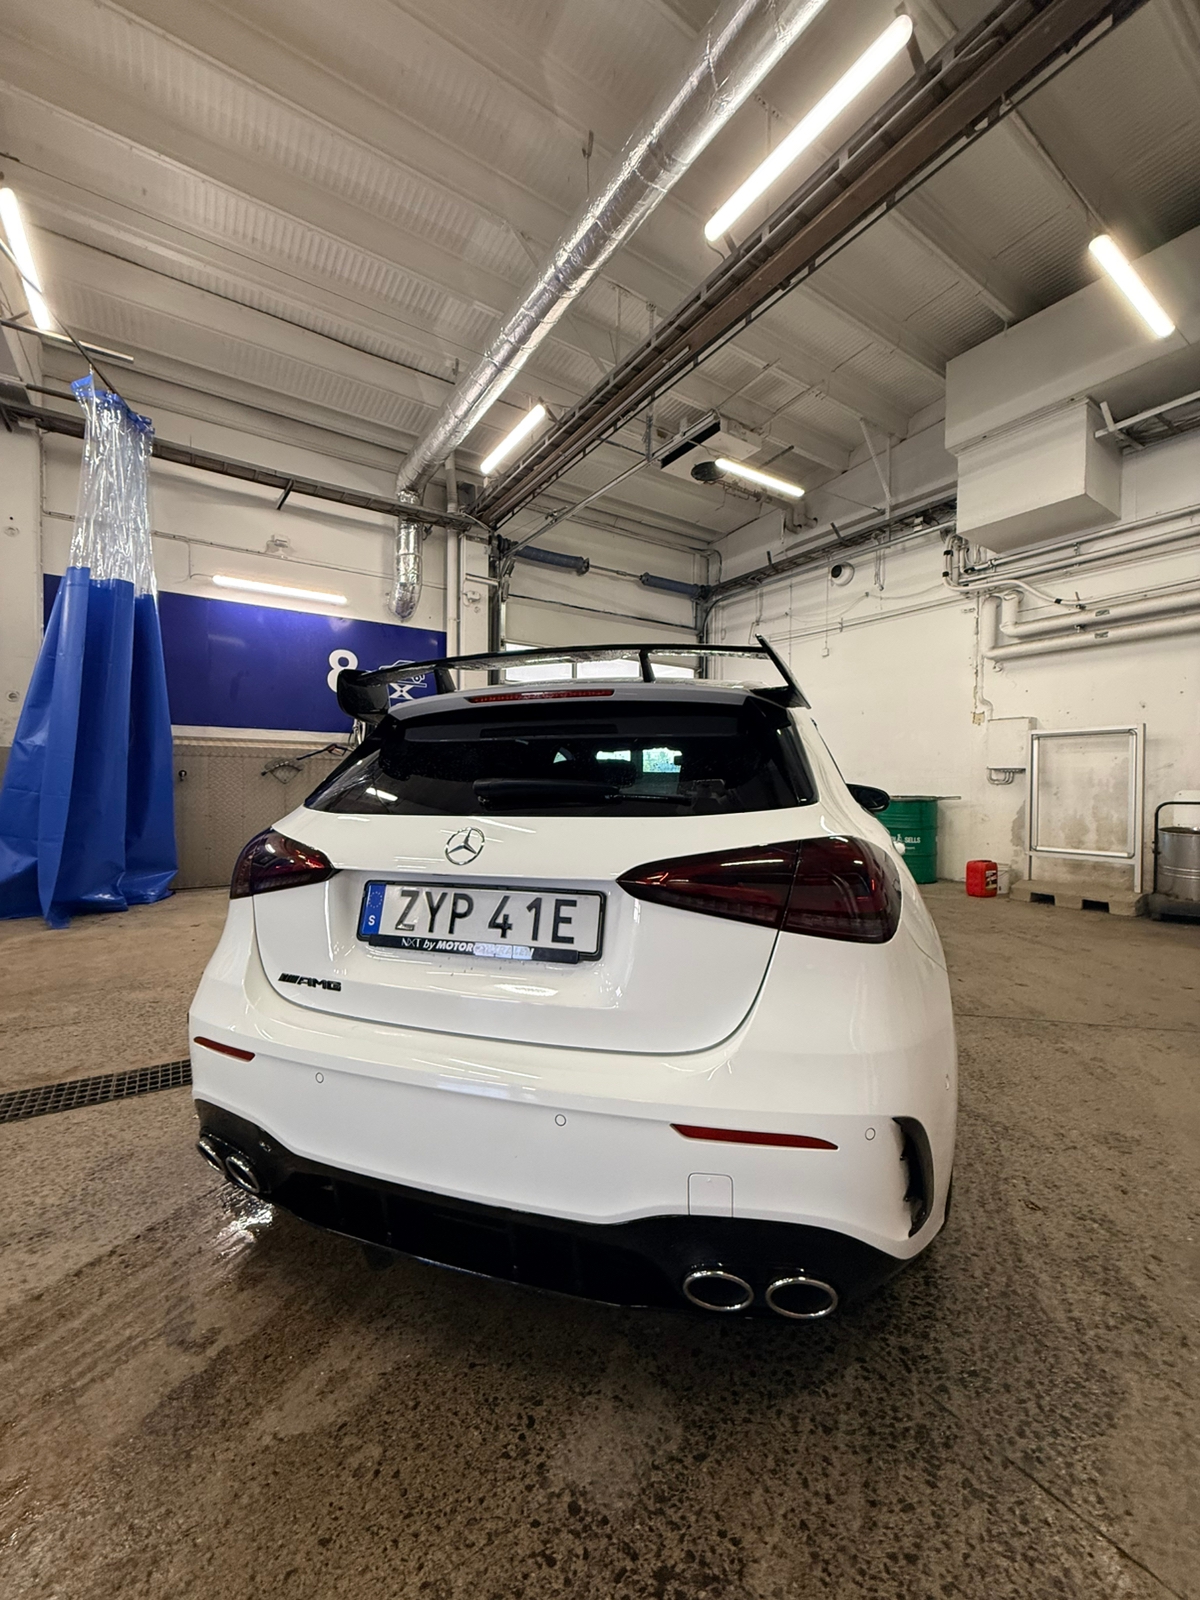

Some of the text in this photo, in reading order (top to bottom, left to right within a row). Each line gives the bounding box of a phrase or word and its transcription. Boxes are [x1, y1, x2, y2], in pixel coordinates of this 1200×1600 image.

[327, 649, 358, 693] 8
[367, 914, 376, 926] S
[394, 889, 578, 945] ZYP 41E
[401, 938, 535, 959] NXT by MOTORNTRALEN
[297, 976, 342, 992] AMG
